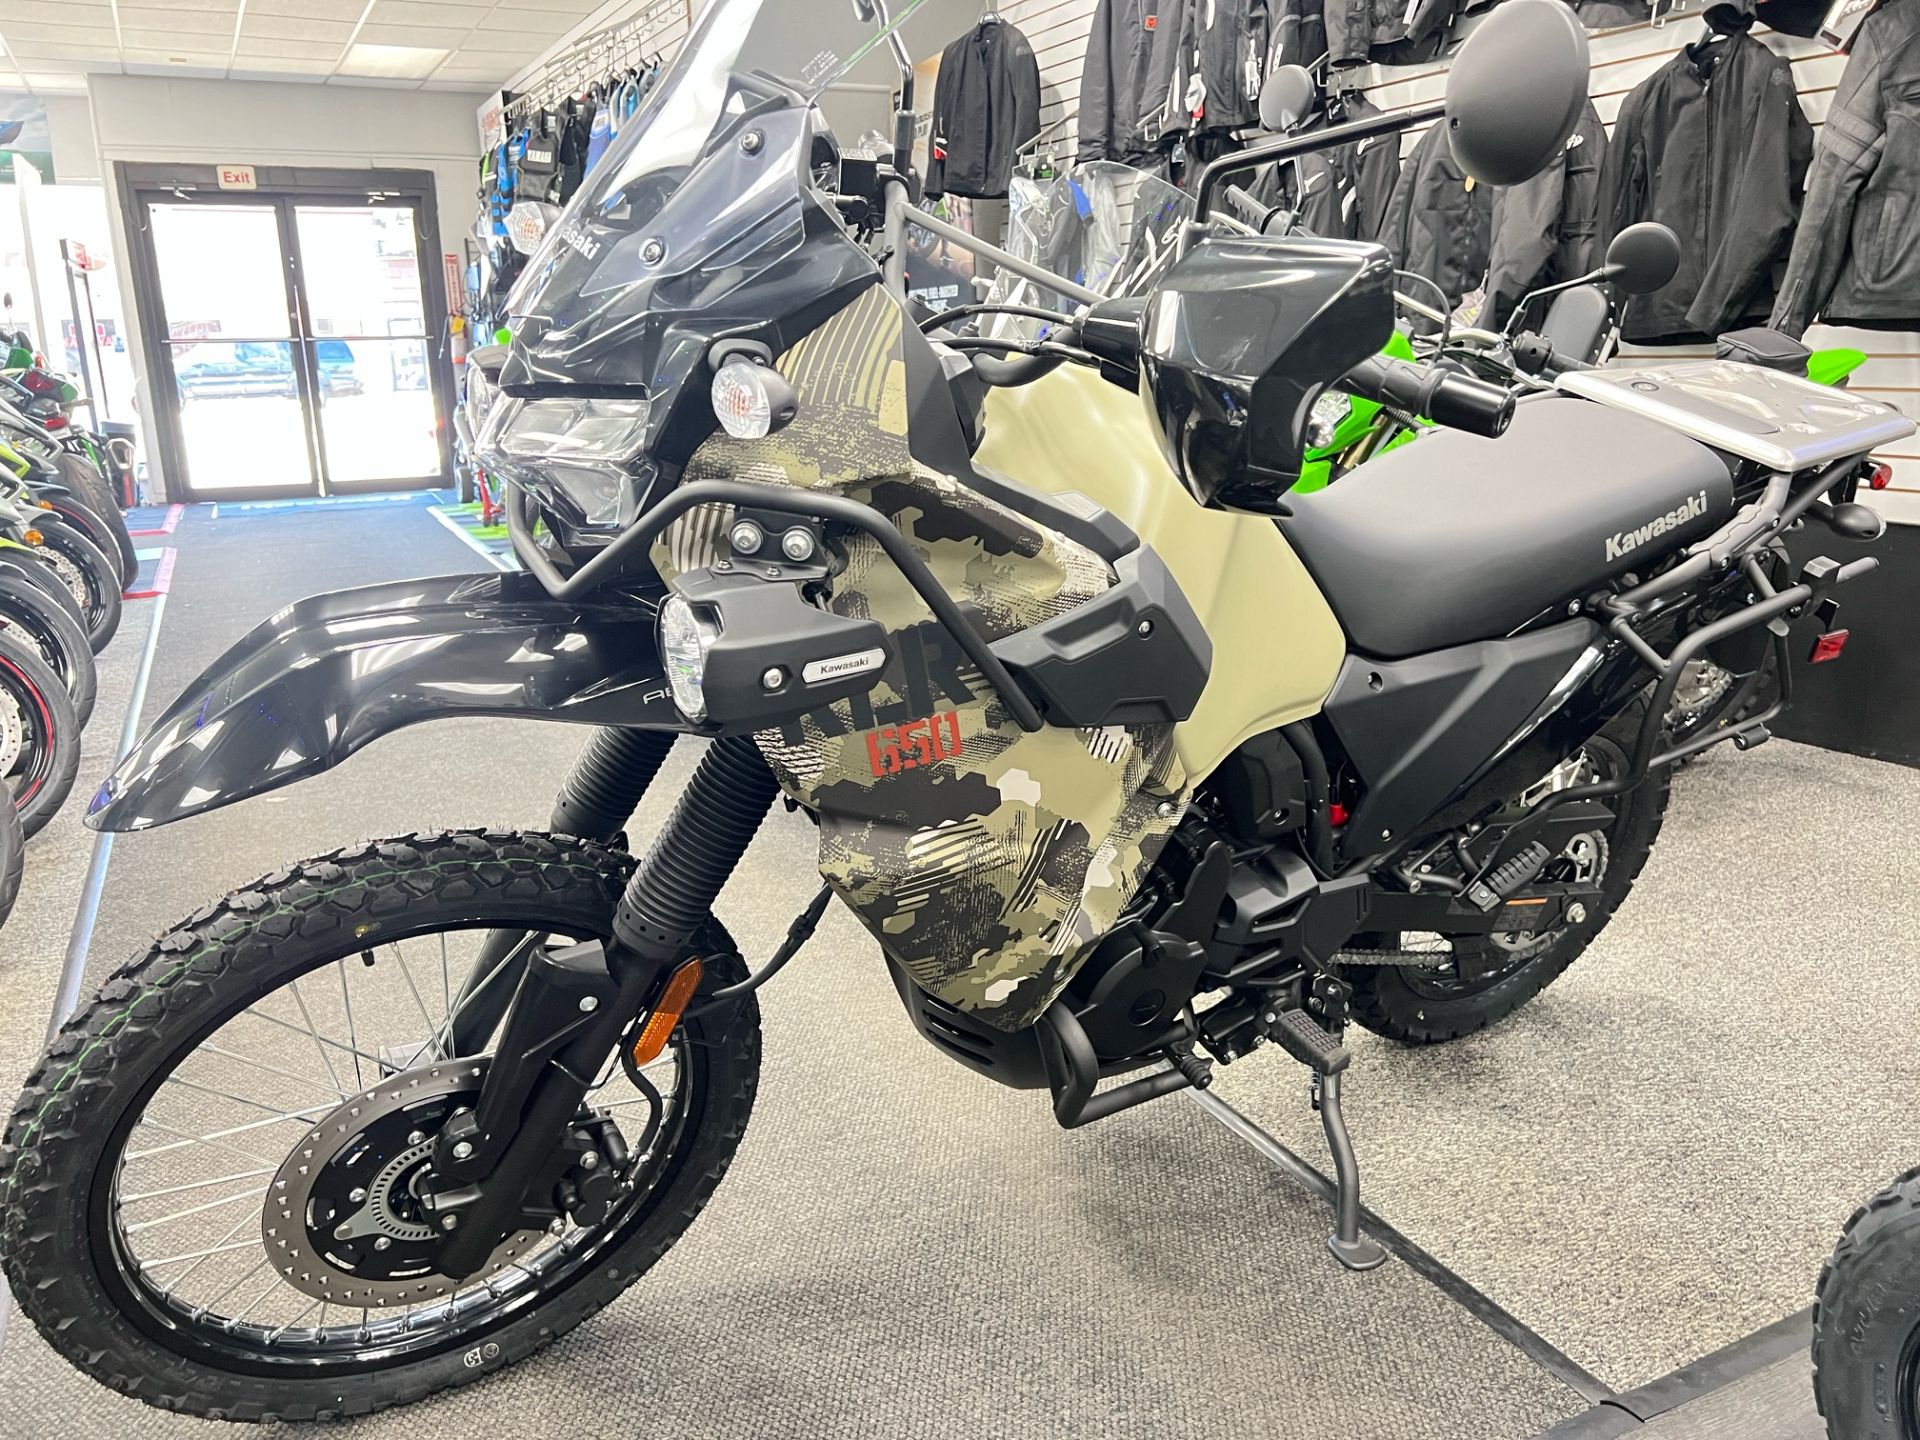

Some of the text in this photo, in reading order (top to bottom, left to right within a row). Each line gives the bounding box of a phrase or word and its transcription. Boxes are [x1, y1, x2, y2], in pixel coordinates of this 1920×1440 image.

[223, 171, 250, 183] Exit
[1605, 490, 1707, 562] Kawasaki
[820, 657, 869, 675] Kawasaki
[866, 710, 964, 777] 650
